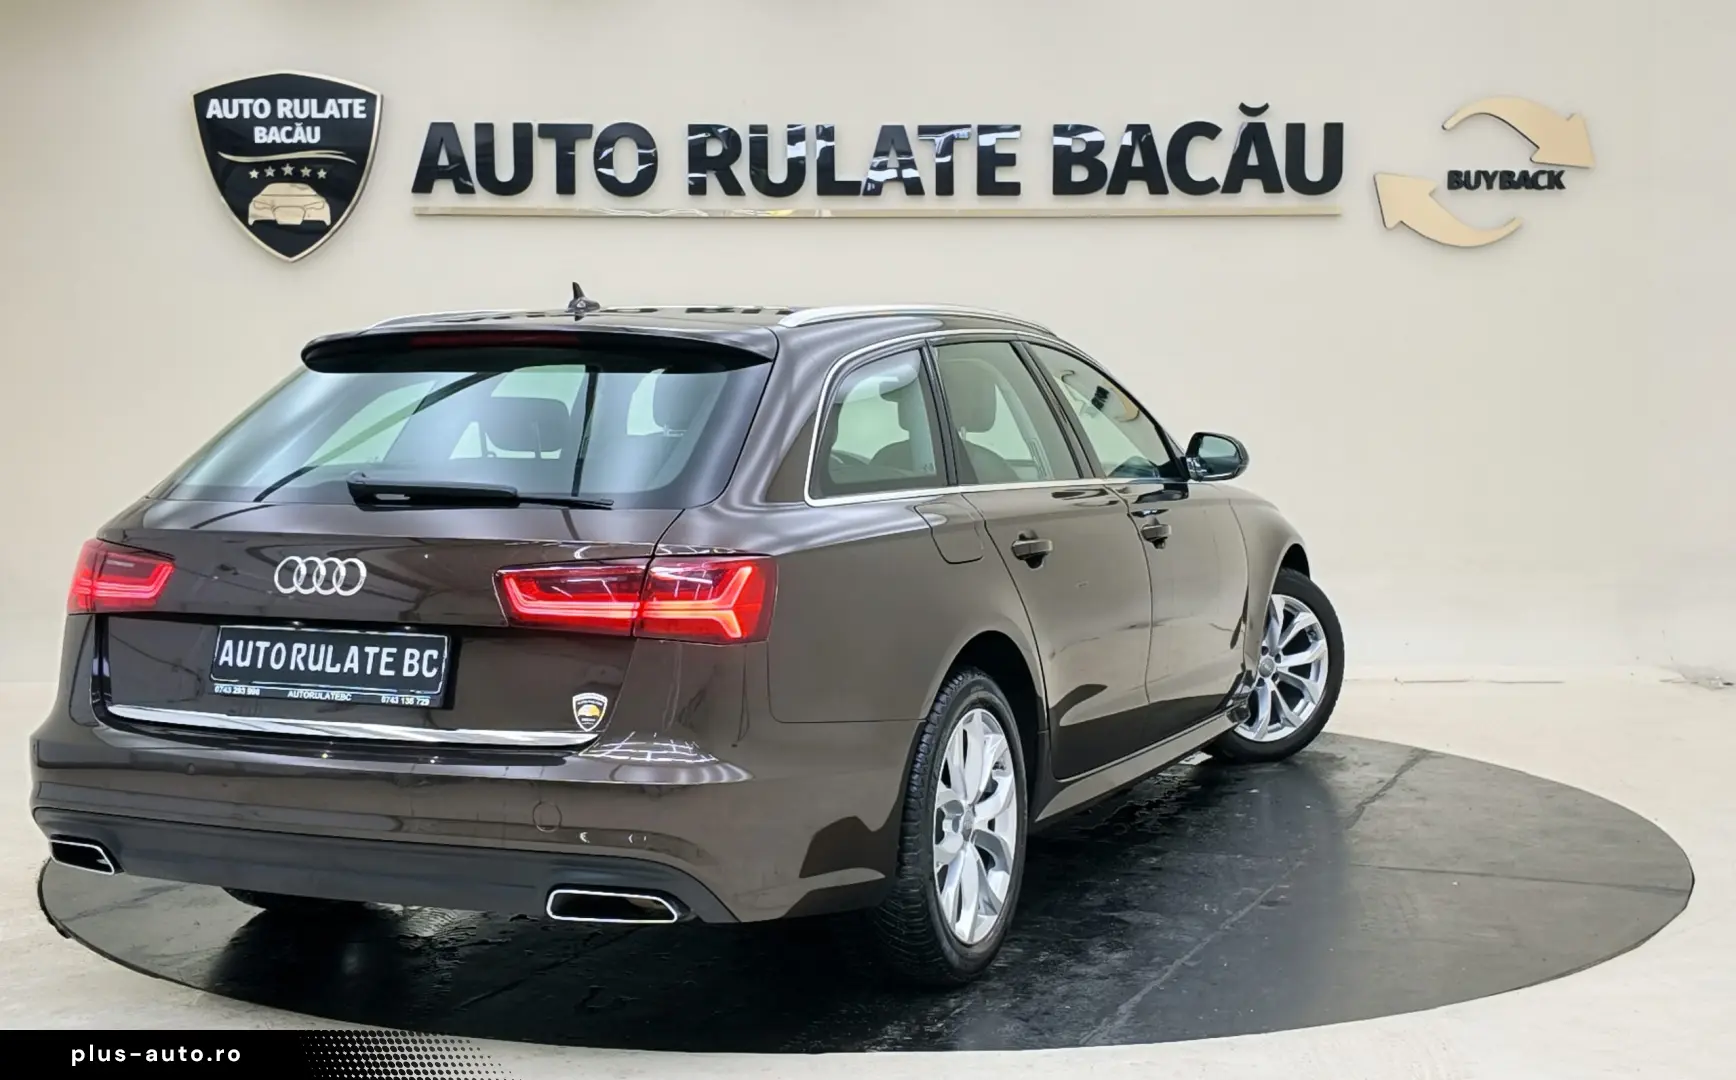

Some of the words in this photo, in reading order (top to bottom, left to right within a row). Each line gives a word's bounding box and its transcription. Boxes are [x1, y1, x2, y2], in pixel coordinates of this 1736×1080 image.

[206, 98, 271, 119] AUTO
[277, 98, 367, 119] RULATE
[254, 122, 321, 144] BACĂU
[411, 121, 659, 197] AUTO
[687, 122, 1021, 198] RULATE
[1052, 101, 1344, 197] BACĂU
[1447, 169, 1566, 191] BUYBACK
[402, 648, 439, 678] BC
